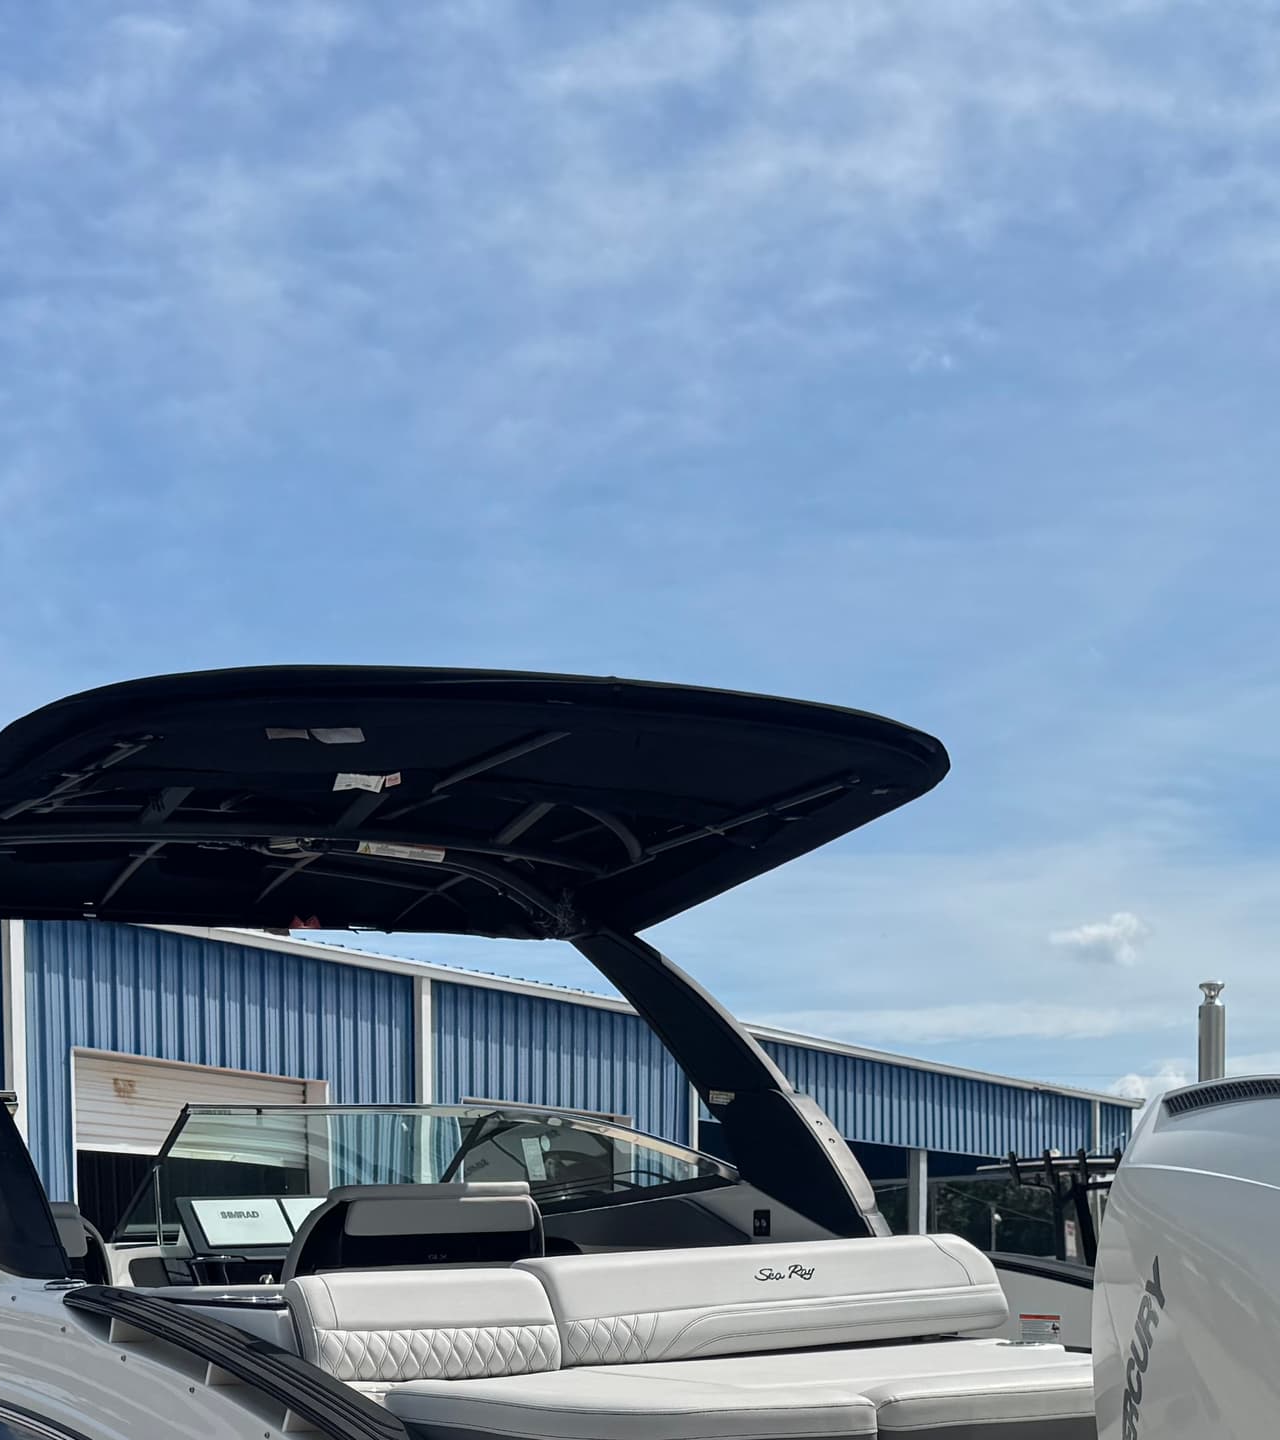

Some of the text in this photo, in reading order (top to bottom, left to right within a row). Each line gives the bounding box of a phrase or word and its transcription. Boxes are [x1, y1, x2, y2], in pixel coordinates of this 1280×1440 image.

[220, 1210, 260, 1219] SIMRAD
[754, 1264, 815, 1281] Sea Ray
